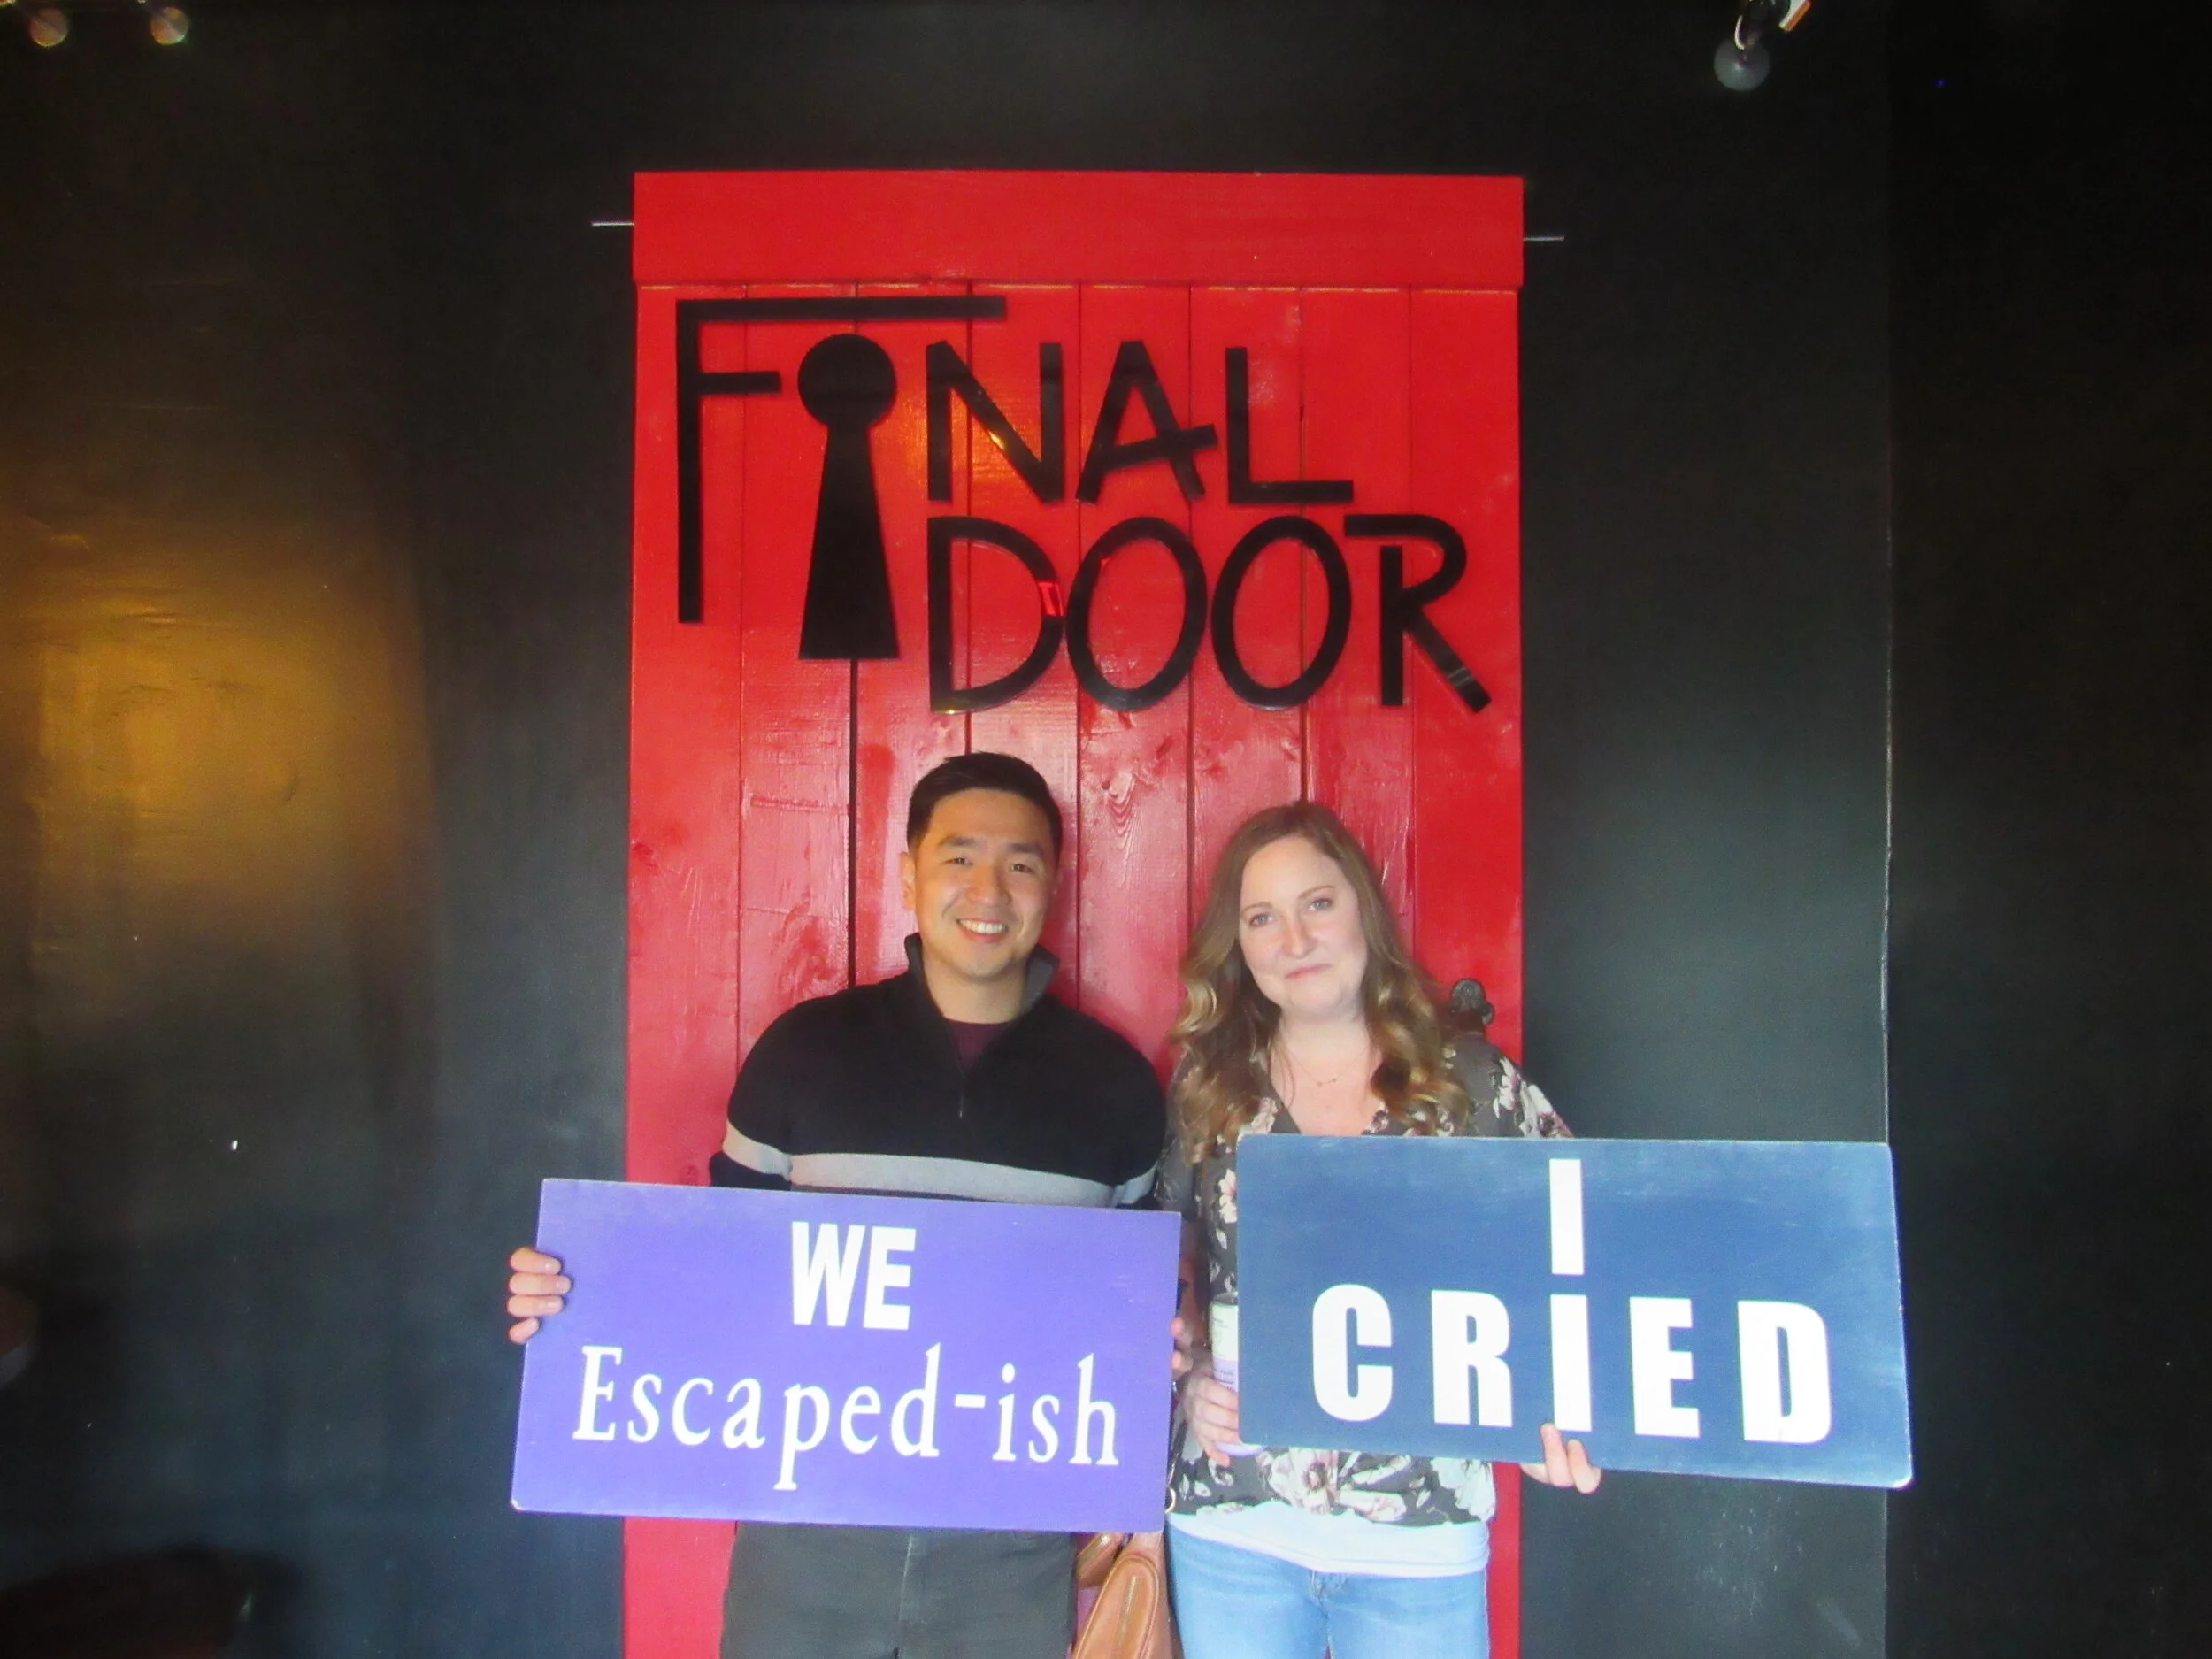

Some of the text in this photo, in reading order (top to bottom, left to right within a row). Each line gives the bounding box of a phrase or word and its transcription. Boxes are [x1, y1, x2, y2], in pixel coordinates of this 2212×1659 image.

[676, 296, 1353, 659] FINAL
[927, 514, 1490, 712] DOOR
[791, 1222, 917, 1330] WE
[1548, 1158, 1585, 1275] I
[572, 1342, 1119, 1490] Escaped-ish
[1312, 1284, 1832, 1444] CRIED
